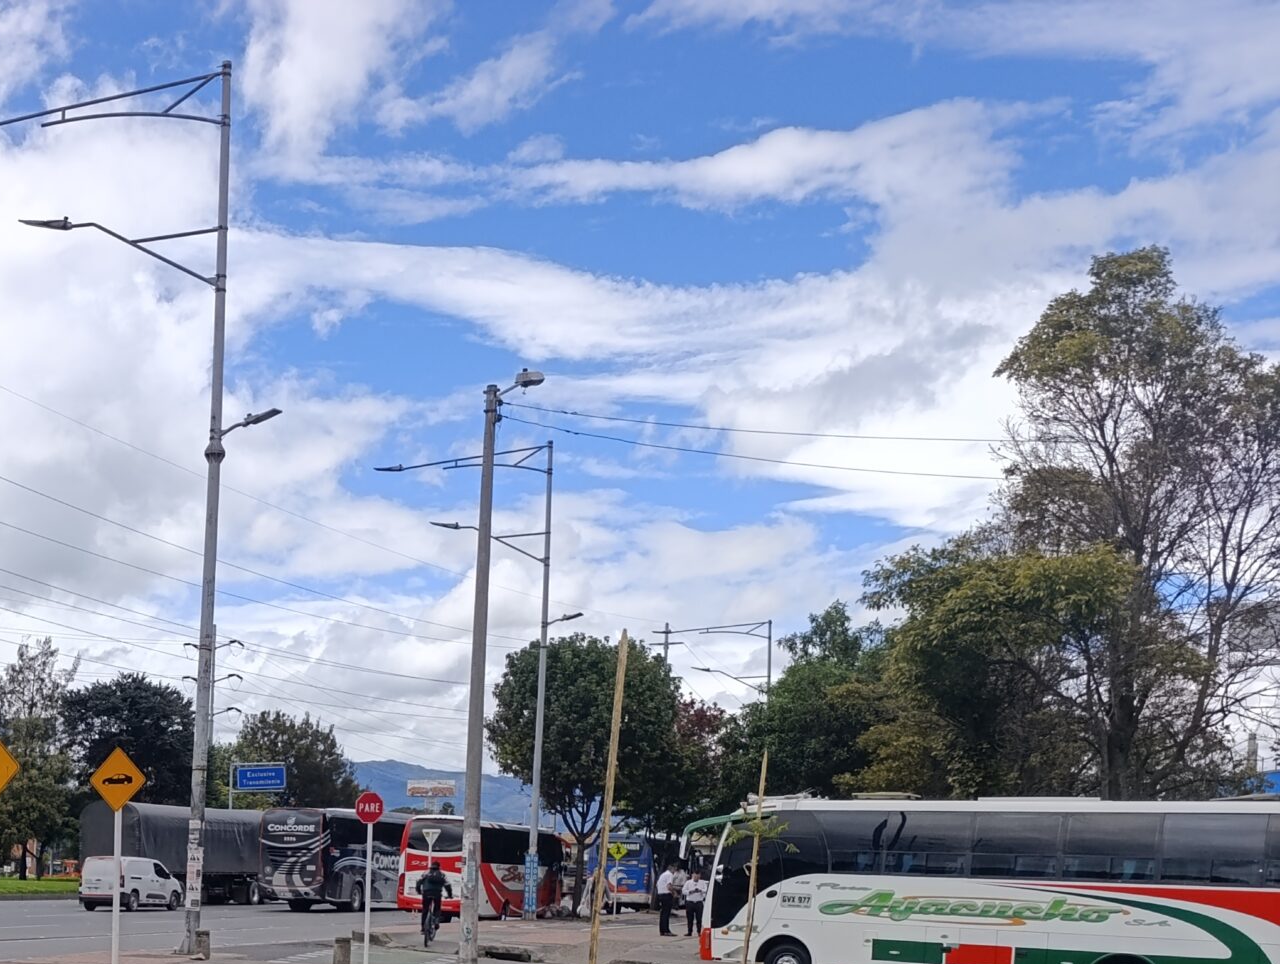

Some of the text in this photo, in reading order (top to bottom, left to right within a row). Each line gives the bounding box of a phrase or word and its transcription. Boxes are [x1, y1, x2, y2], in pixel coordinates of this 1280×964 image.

[359, 802, 381, 813] PARE
[267, 823, 316, 832] CONCORDE
[782, 895, 811, 905] GVX 977
[819, 889, 1124, 923] Ayacucho
